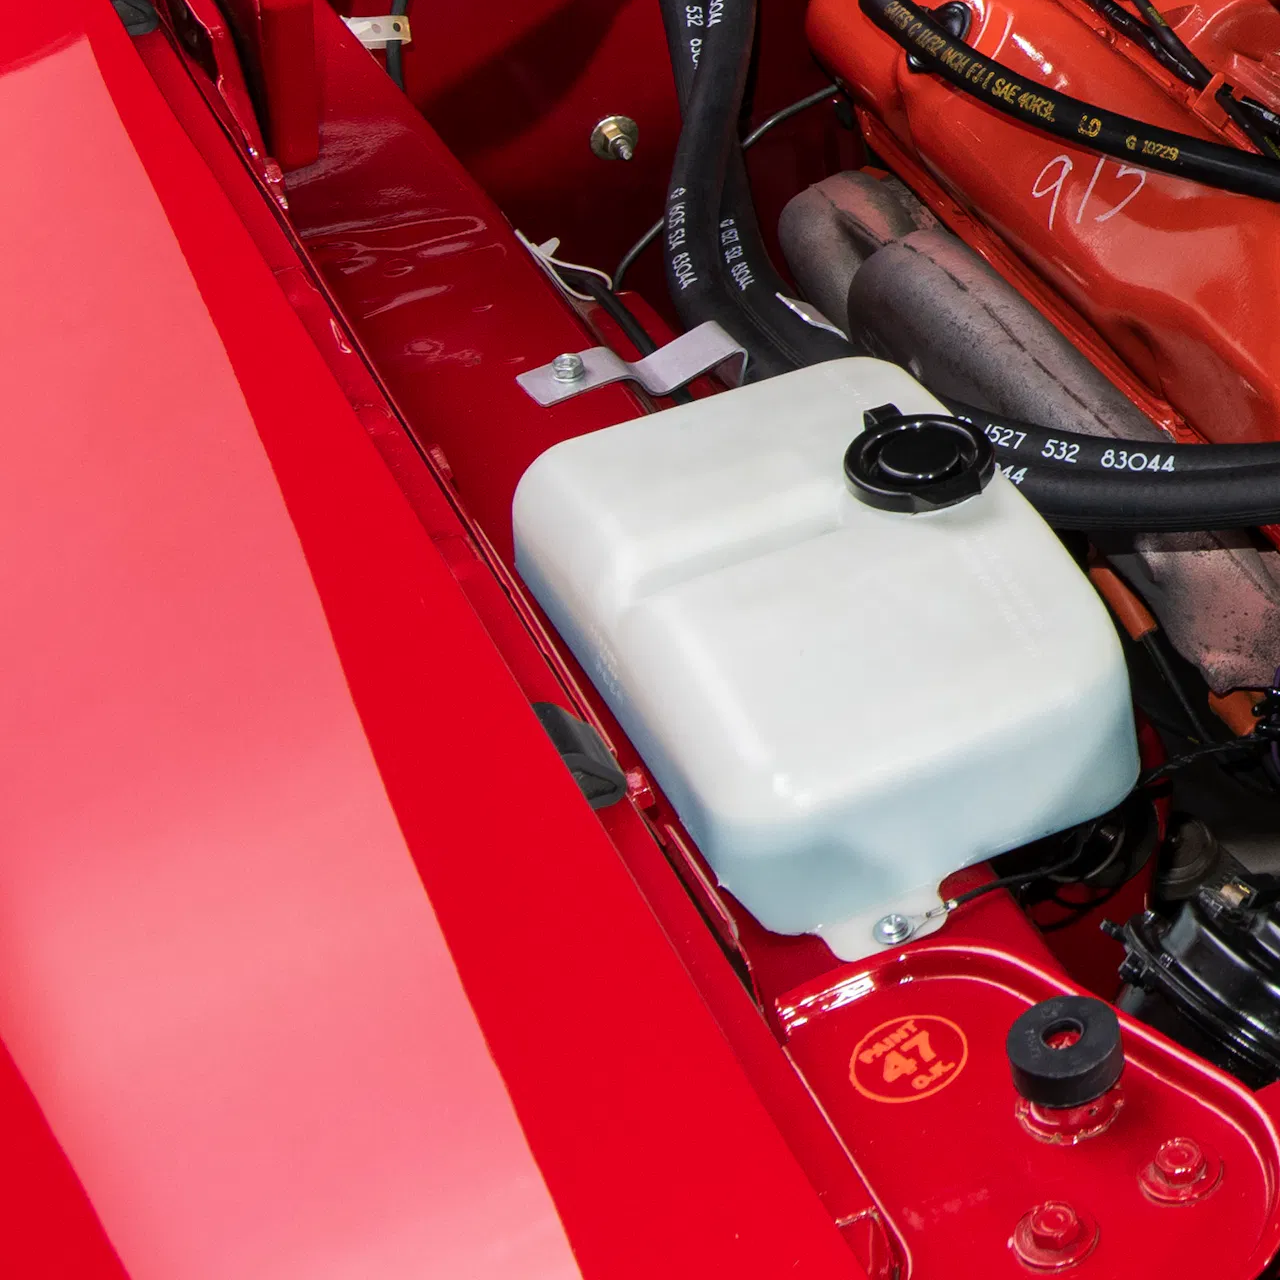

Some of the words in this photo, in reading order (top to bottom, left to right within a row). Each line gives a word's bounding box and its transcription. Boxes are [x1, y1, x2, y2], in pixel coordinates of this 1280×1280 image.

[685, 5, 704, 27] 532
[940, 47, 971, 75] INCH
[992, 77, 1022, 105] SAE
[1141, 138, 1180, 162] 10729
[672, 252, 698, 290] 83044
[984, 423, 1028, 450] 1527
[1041, 438, 1081, 464] 532
[1100, 448, 1176, 473] 83044
[858, 1019, 918, 1064] PAINT
[883, 1029, 937, 1083] 47
